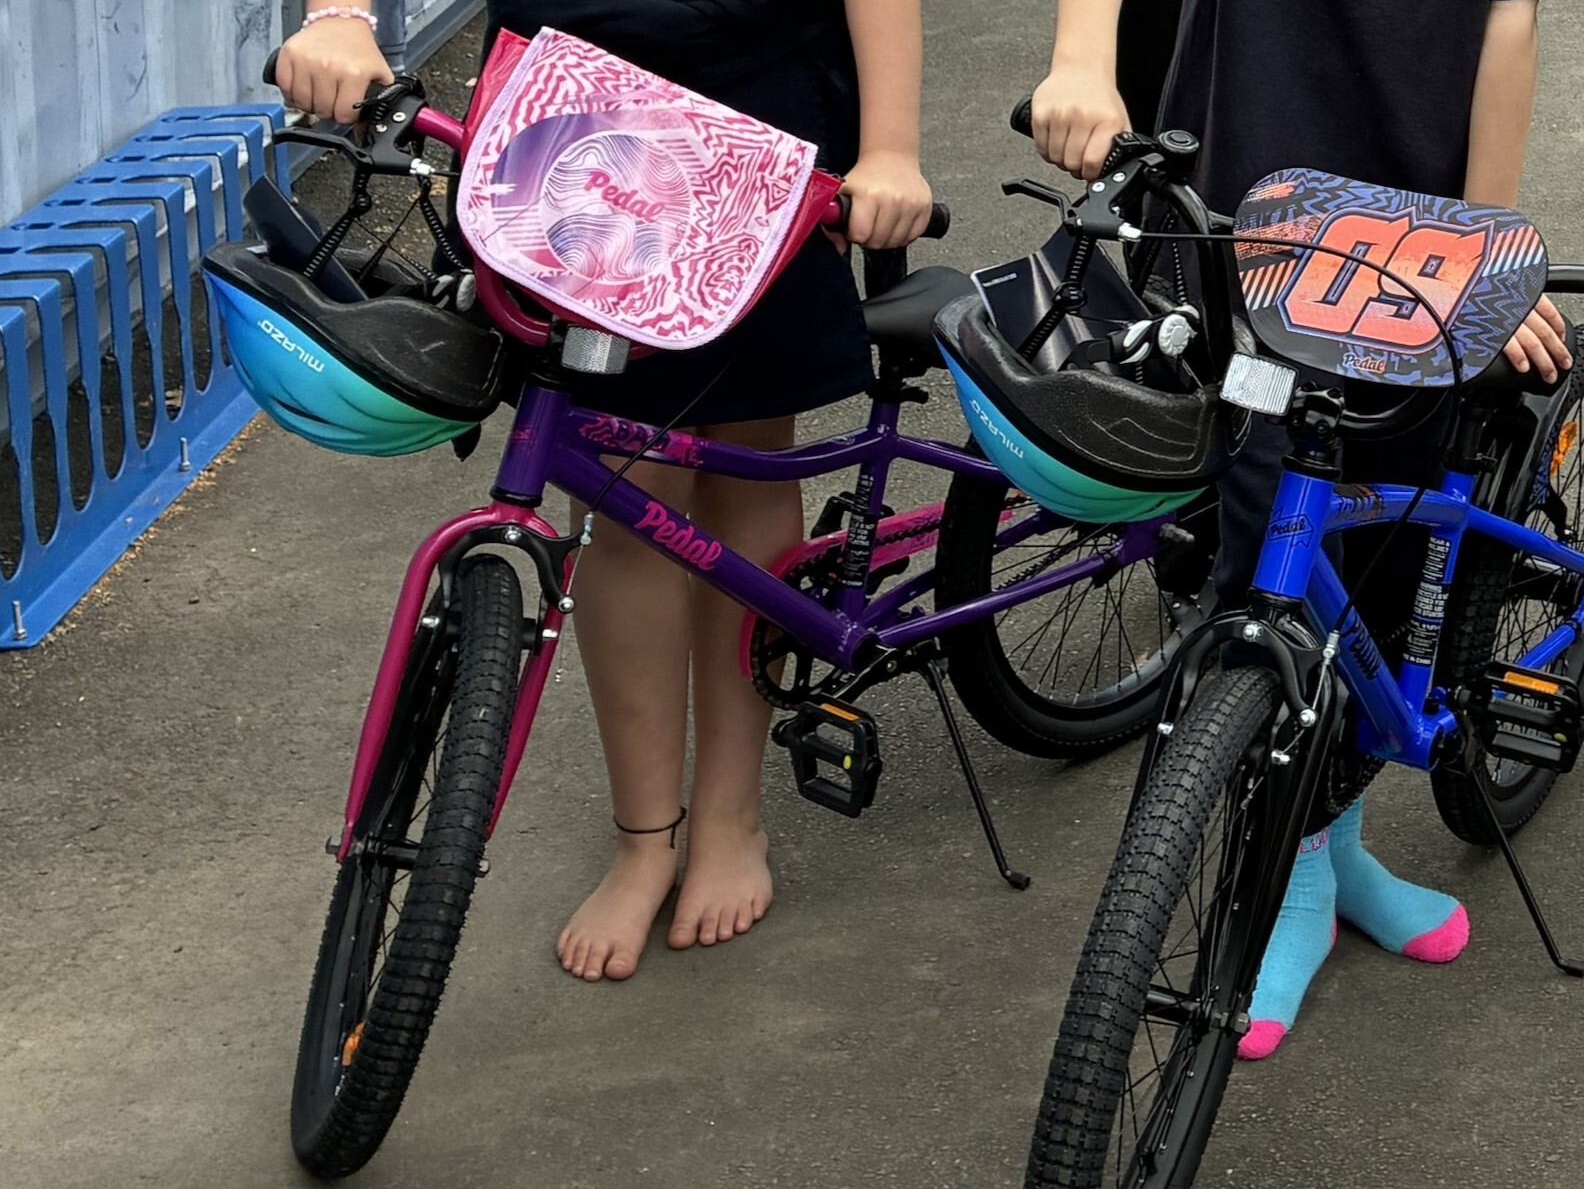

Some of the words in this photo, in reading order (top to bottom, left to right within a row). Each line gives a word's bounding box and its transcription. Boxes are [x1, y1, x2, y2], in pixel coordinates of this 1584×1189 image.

[584, 170, 665, 223] Pedal
[1281, 210, 1490, 350] 09
[1342, 352, 1386, 373] Pedal
[634, 501, 722, 570] Pedal
[1270, 518, 1306, 535] Pedal
